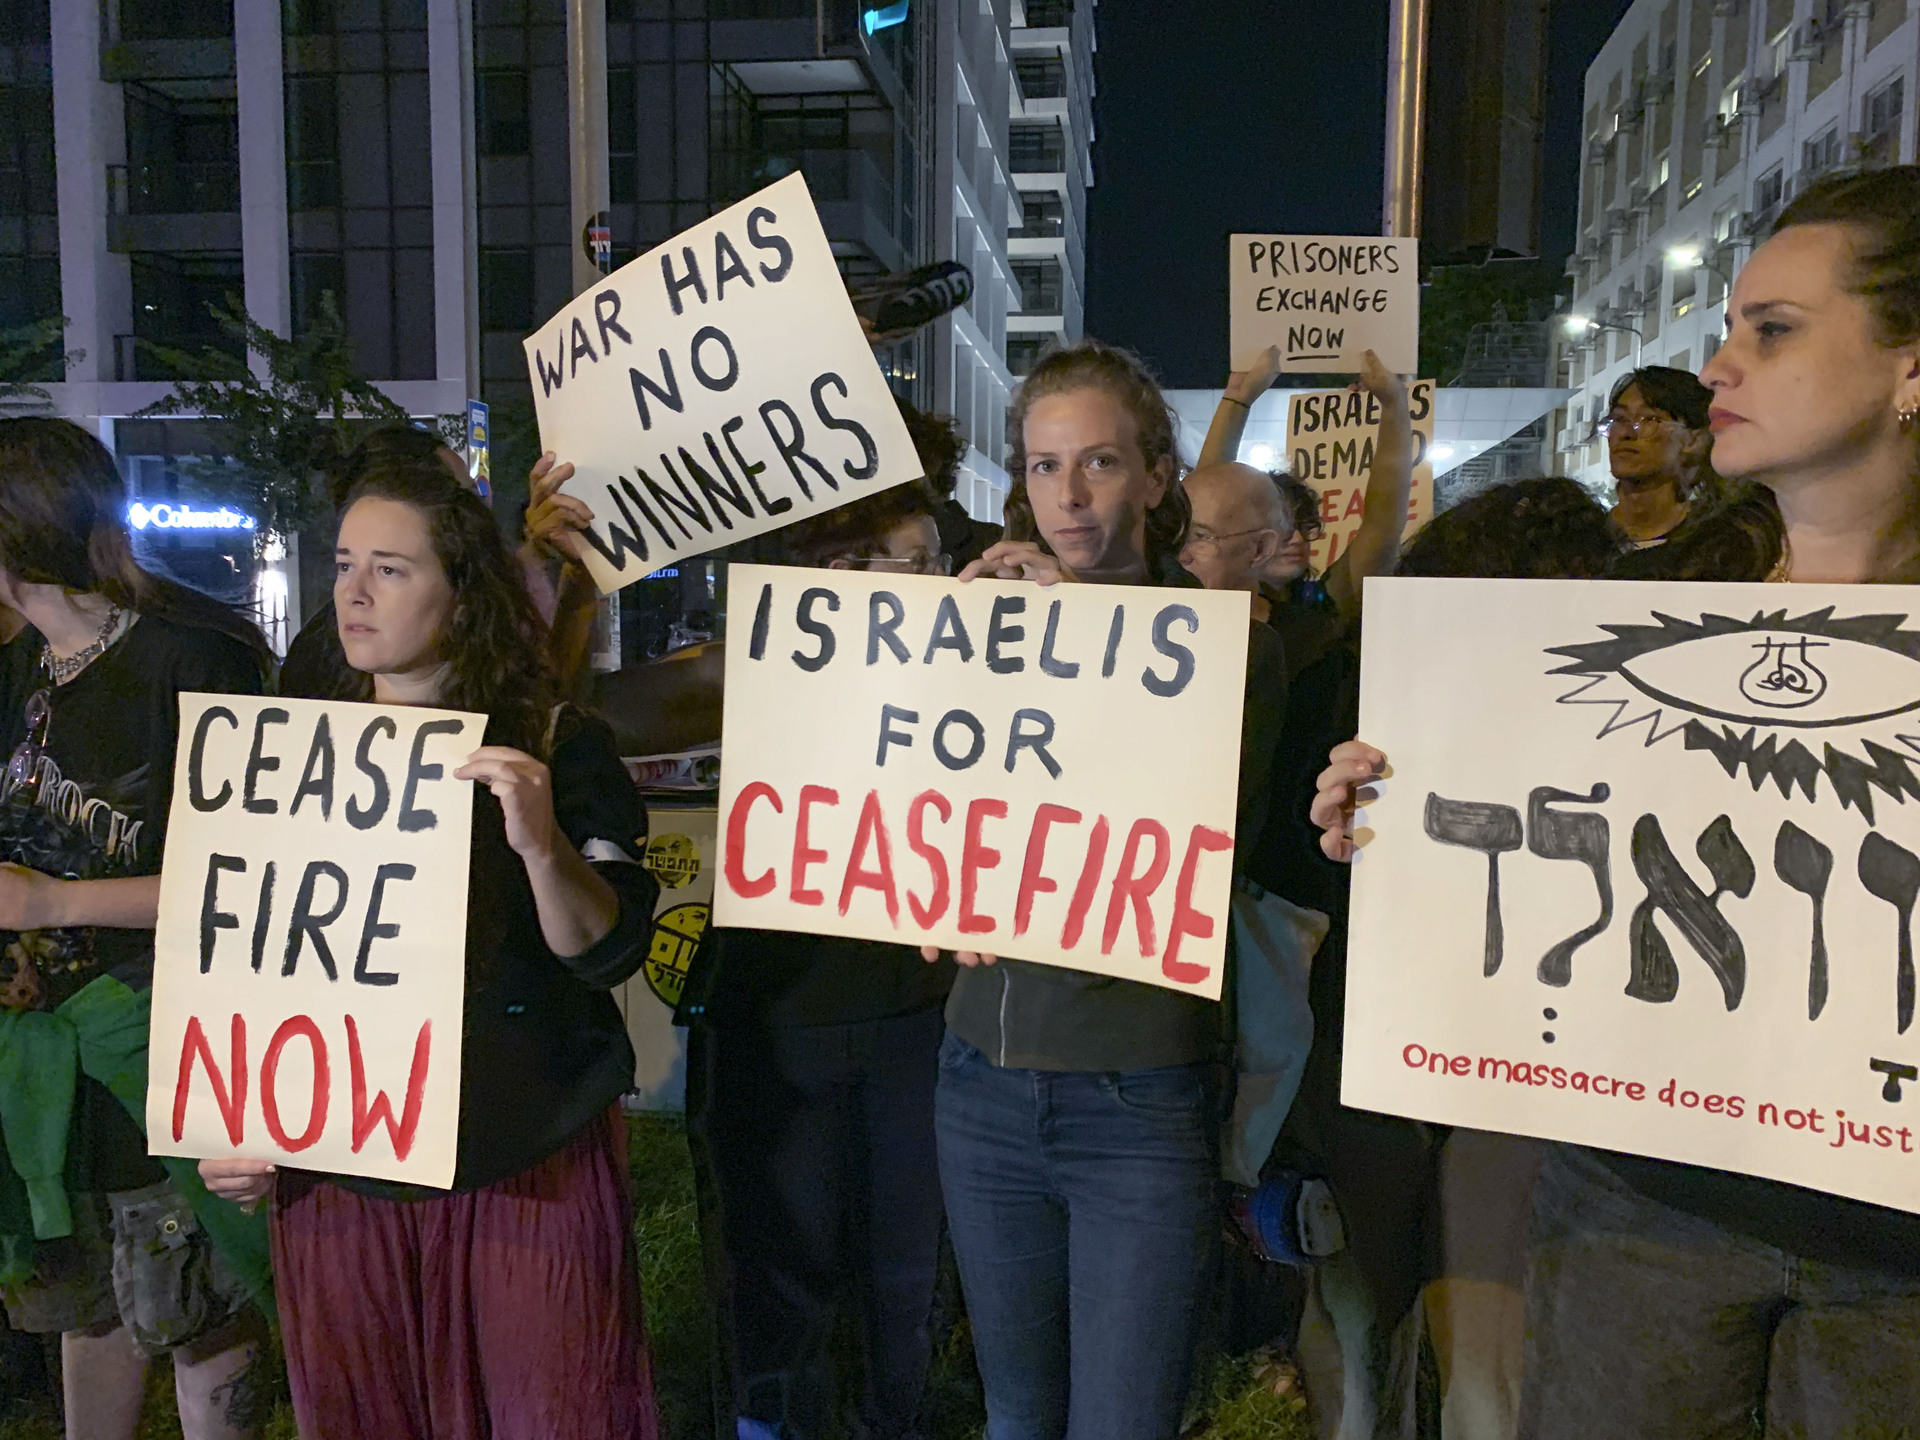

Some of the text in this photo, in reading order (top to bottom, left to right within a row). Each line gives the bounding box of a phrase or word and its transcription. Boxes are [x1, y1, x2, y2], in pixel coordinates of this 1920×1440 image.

[536, 206, 794, 398] WAR HAS
[1249, 241, 1399, 278] PRISONERS
[1256, 286, 1388, 315] EXCHANGE
[629, 326, 739, 430] NO
[1287, 324, 1344, 353] NOW
[1293, 383, 1430, 436] ISRAES
[1294, 429, 1427, 480] DEMAD
[581, 372, 879, 571] WINNERS
[748, 583, 1199, 697] ISRAELIS
[188, 706, 464, 833] CEASE
[876, 703, 1063, 780] FOR
[199, 853, 416, 986] FIRE
[724, 780, 1234, 984] CEASEFIRE
[172, 1013, 431, 1163] NOW
[1402, 1042, 1920, 1154] One massacre does not just
